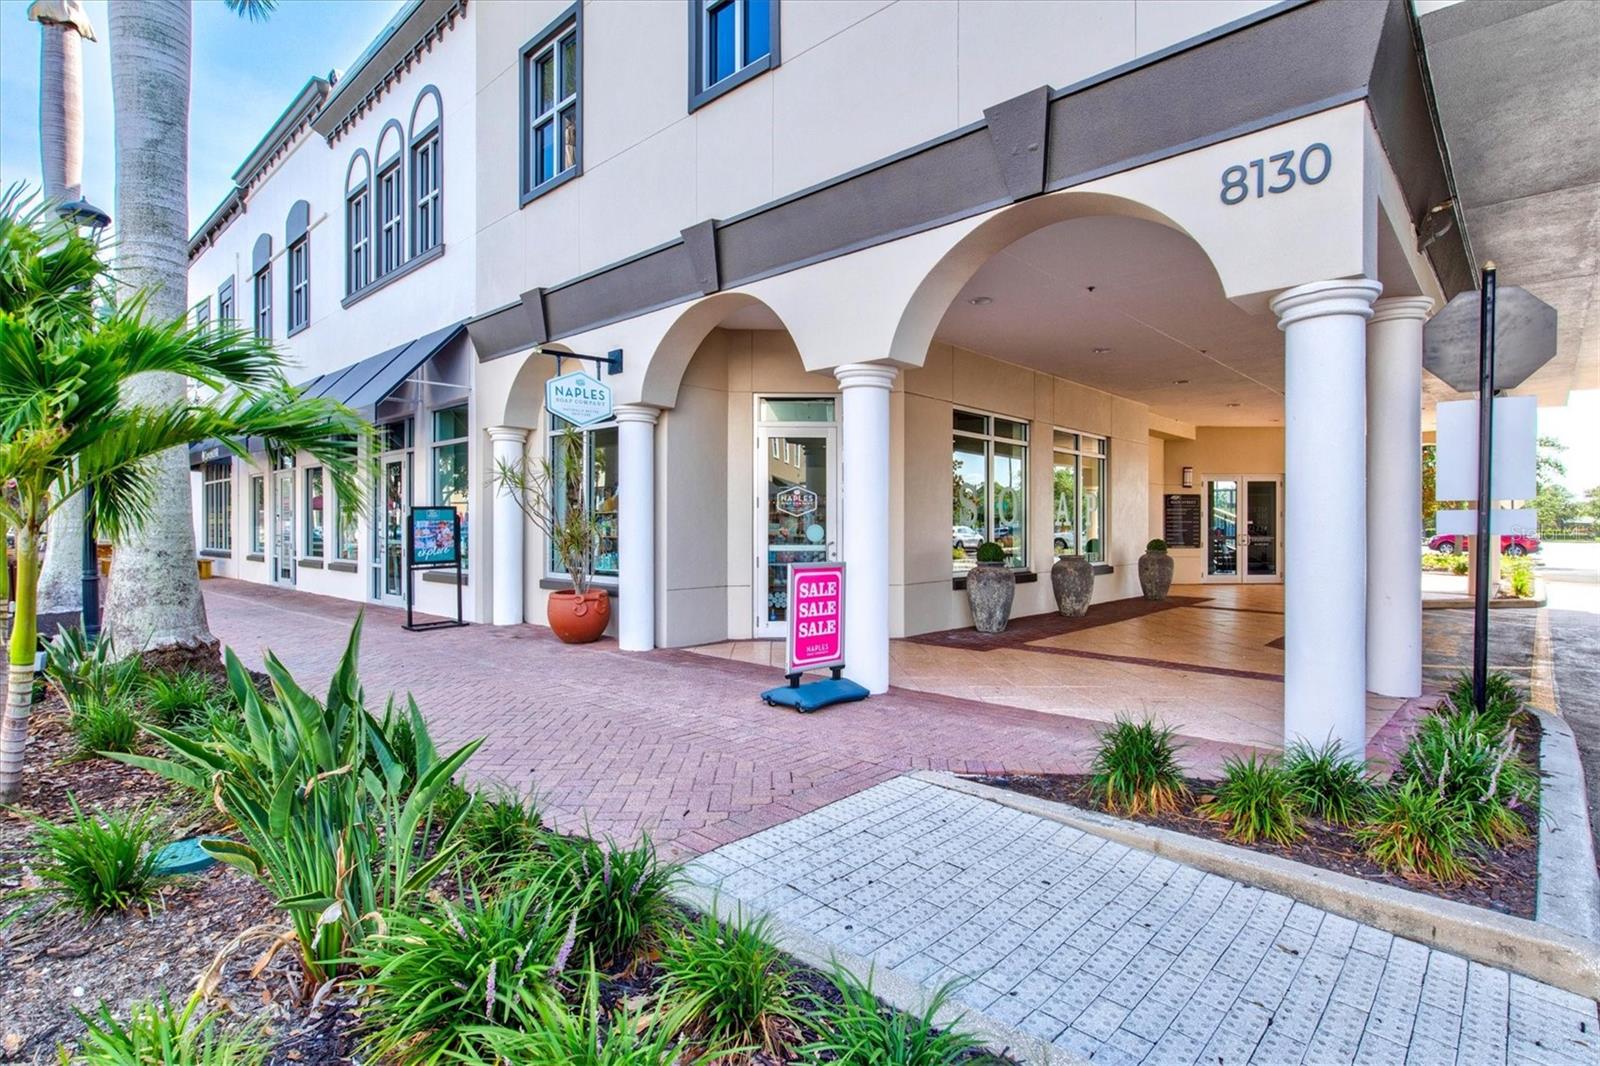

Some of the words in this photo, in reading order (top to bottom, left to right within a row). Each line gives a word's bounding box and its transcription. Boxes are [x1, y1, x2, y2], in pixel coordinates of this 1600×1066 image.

[1220, 142, 1332, 205] 8130
[555, 386, 605, 401] NAPLES
[780, 494, 814, 502] NAPLES
[417, 546, 451, 561] explore
[799, 581, 837, 599] SALE
[799, 601, 837, 618] SALE
[798, 620, 837, 638] SALE
[806, 643, 829, 653] NAPLES
